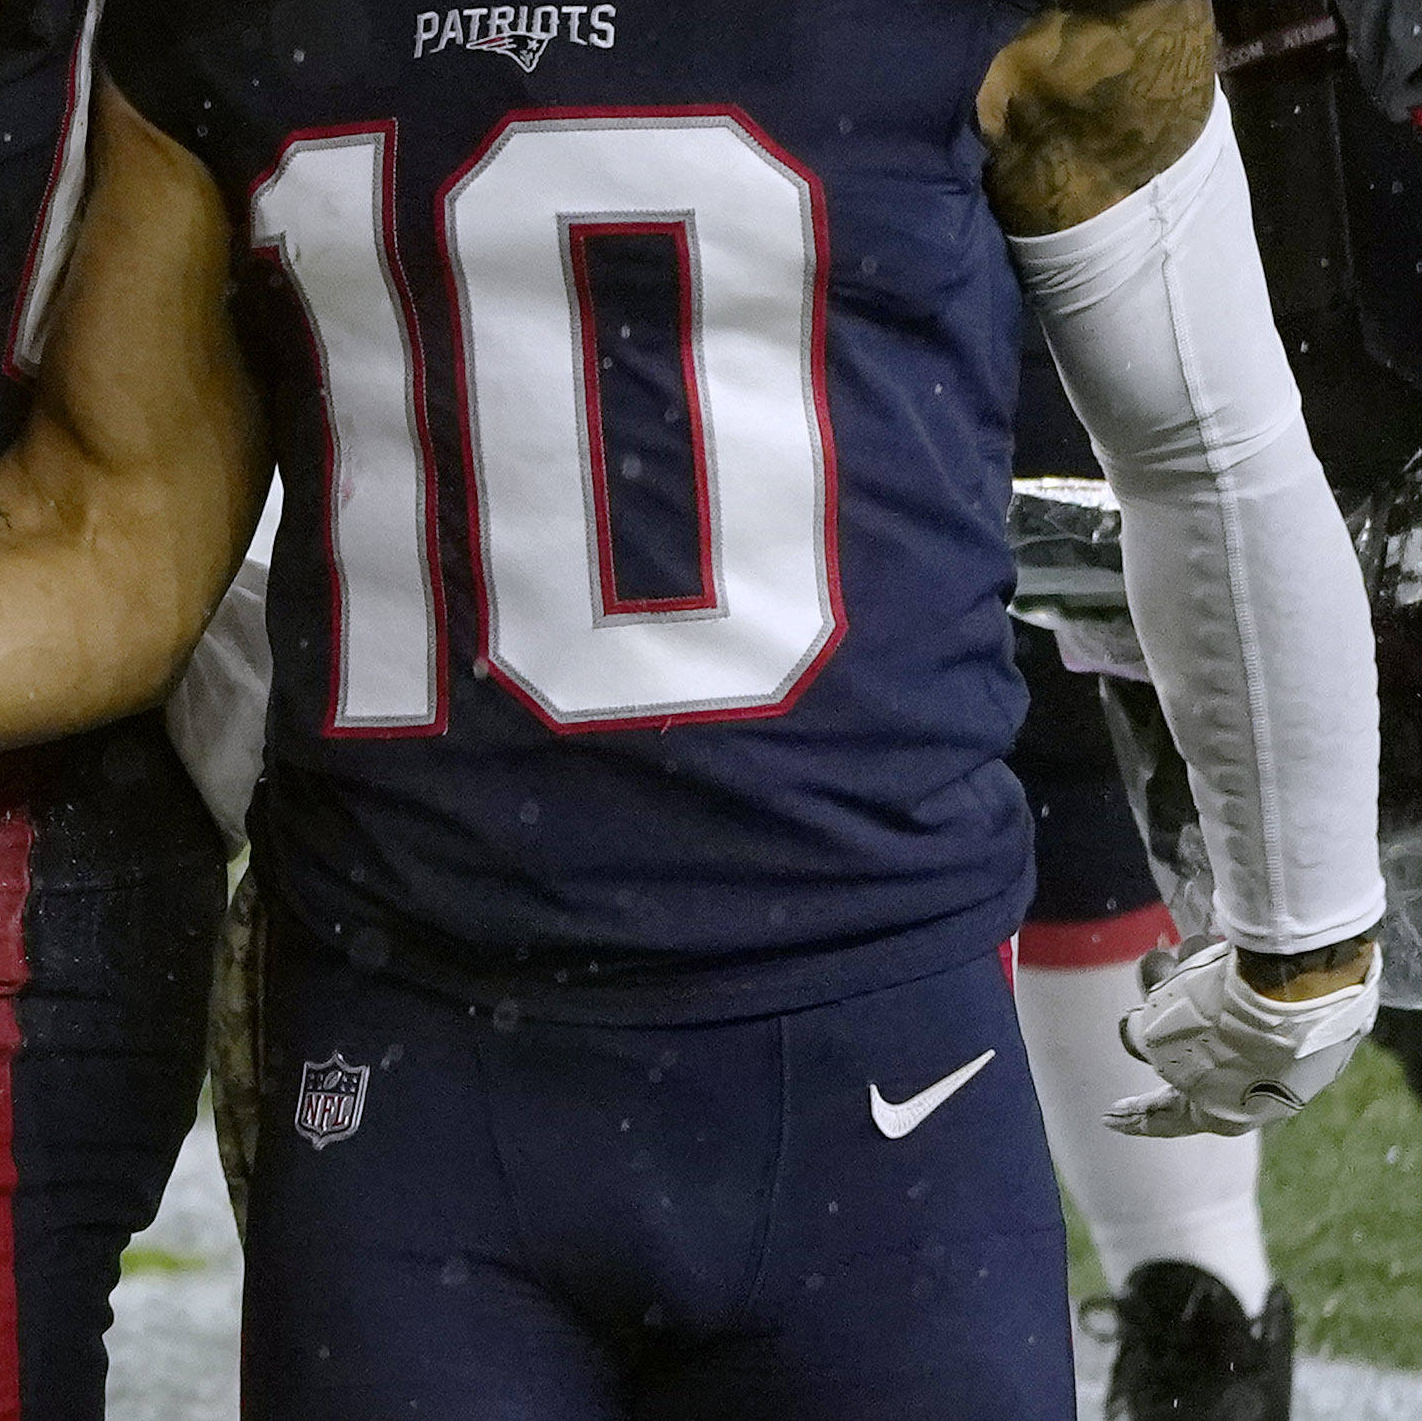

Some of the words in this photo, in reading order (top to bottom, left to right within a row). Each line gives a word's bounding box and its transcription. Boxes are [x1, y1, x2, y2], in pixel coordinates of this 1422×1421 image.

[413, 3, 617, 60] PATRIOTS
[249, 103, 849, 739] 10
[303, 1094, 349, 1130] NFL
